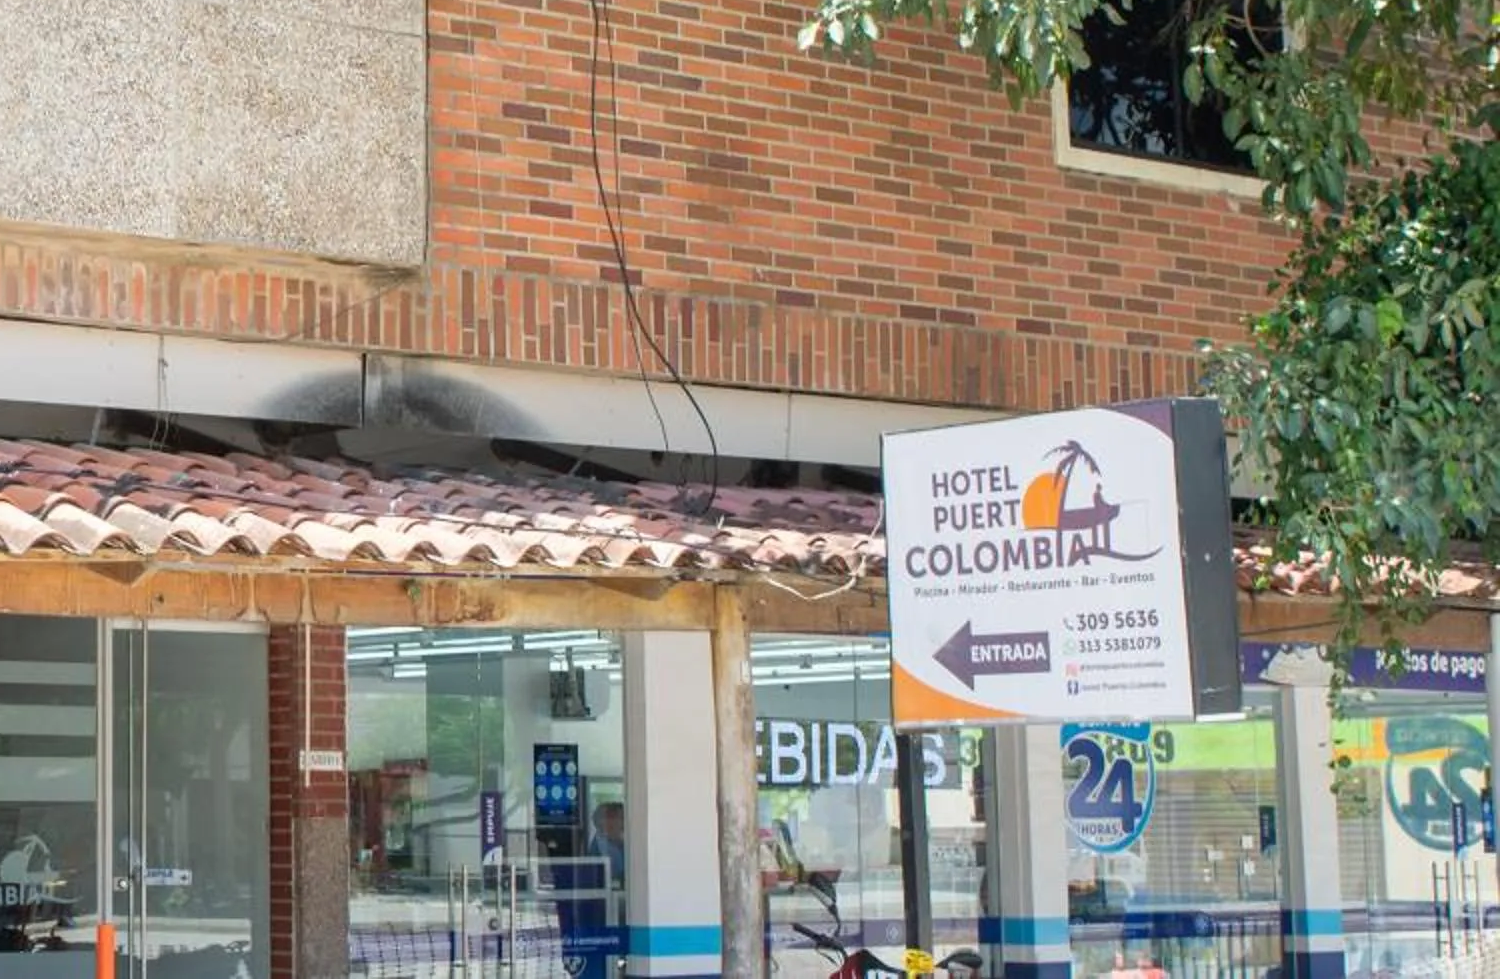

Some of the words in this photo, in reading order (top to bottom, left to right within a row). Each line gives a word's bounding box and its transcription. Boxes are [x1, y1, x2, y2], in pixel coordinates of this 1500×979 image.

[931, 465, 1018, 499] HOTEL
[905, 532, 1091, 579] COLOMBIA
[959, 582, 998, 595] Mirador
[1008, 578, 1071, 592] Restaurante
[1082, 575, 1100, 587] Bar
[1110, 571, 1155, 585] Eventos
[1076, 613, 1109, 632] 309
[1114, 609, 1159, 630] 5636
[971, 643, 1047, 663] ENTRADA
[1079, 639, 1101, 654] 313
[1104, 636, 1162, 652] 5381079
[1430, 649, 1449, 673] de
[1067, 737, 1143, 834] 24
[1081, 823, 1119, 836] HORAS
